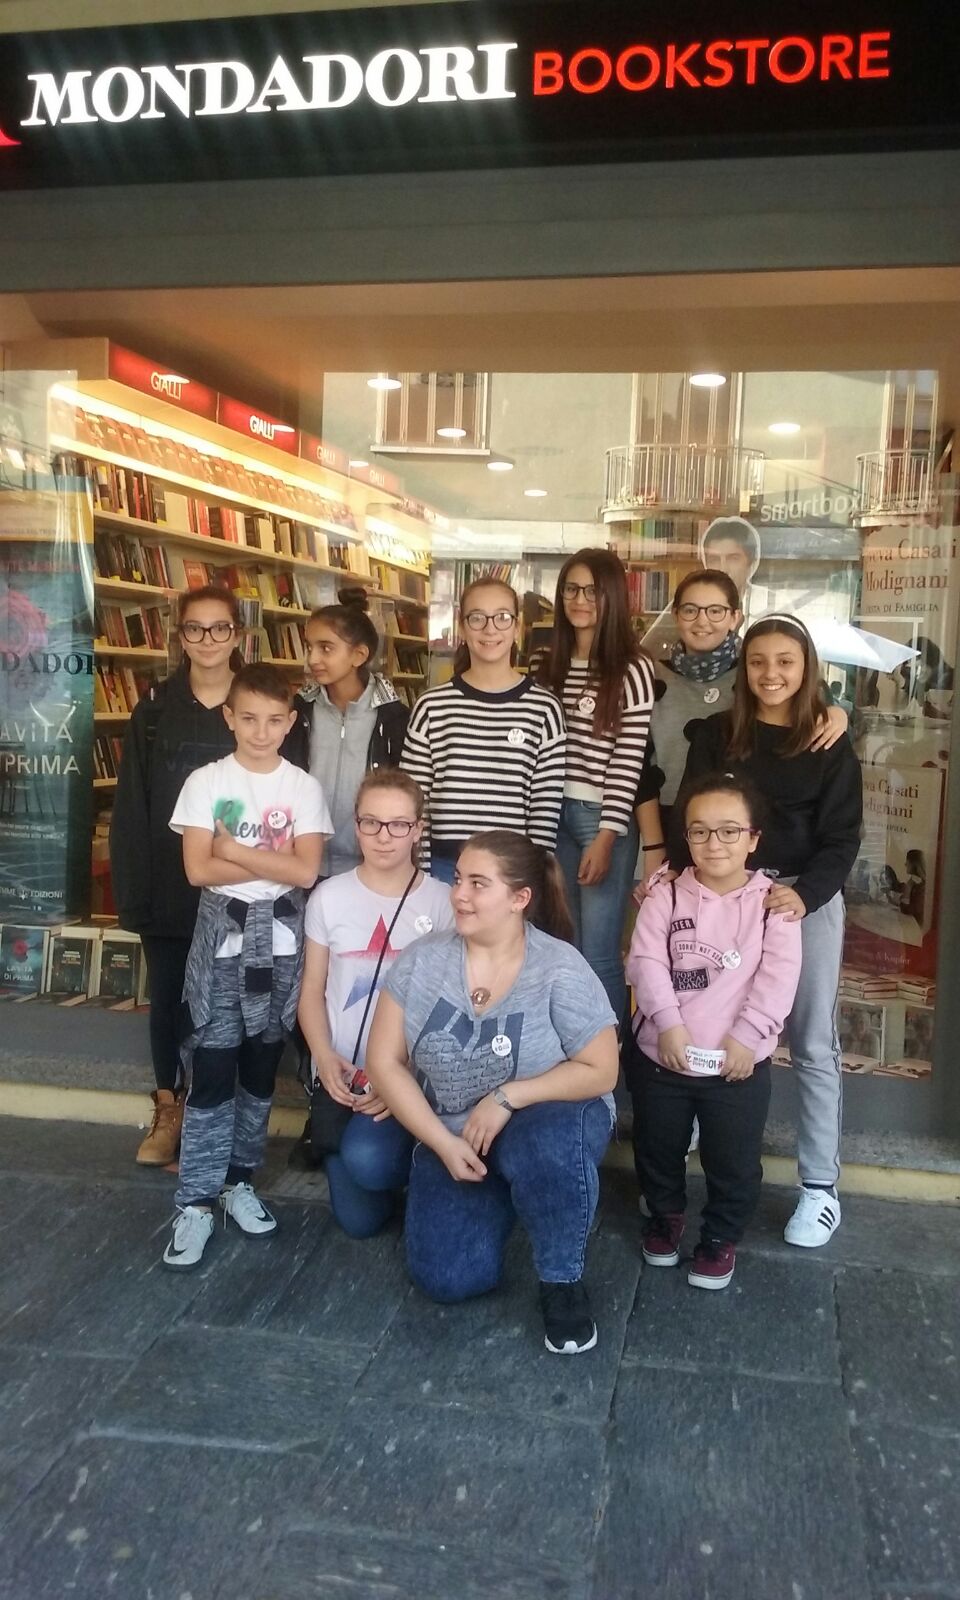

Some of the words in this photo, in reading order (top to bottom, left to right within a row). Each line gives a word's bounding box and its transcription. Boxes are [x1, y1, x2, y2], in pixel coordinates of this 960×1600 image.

[21, 43, 518, 126] MONDADORI
[533, 31, 891, 96] BOOKSTORE
[249, 415, 275, 440] GIALLI
[5, 754, 80, 775] PRIMA
